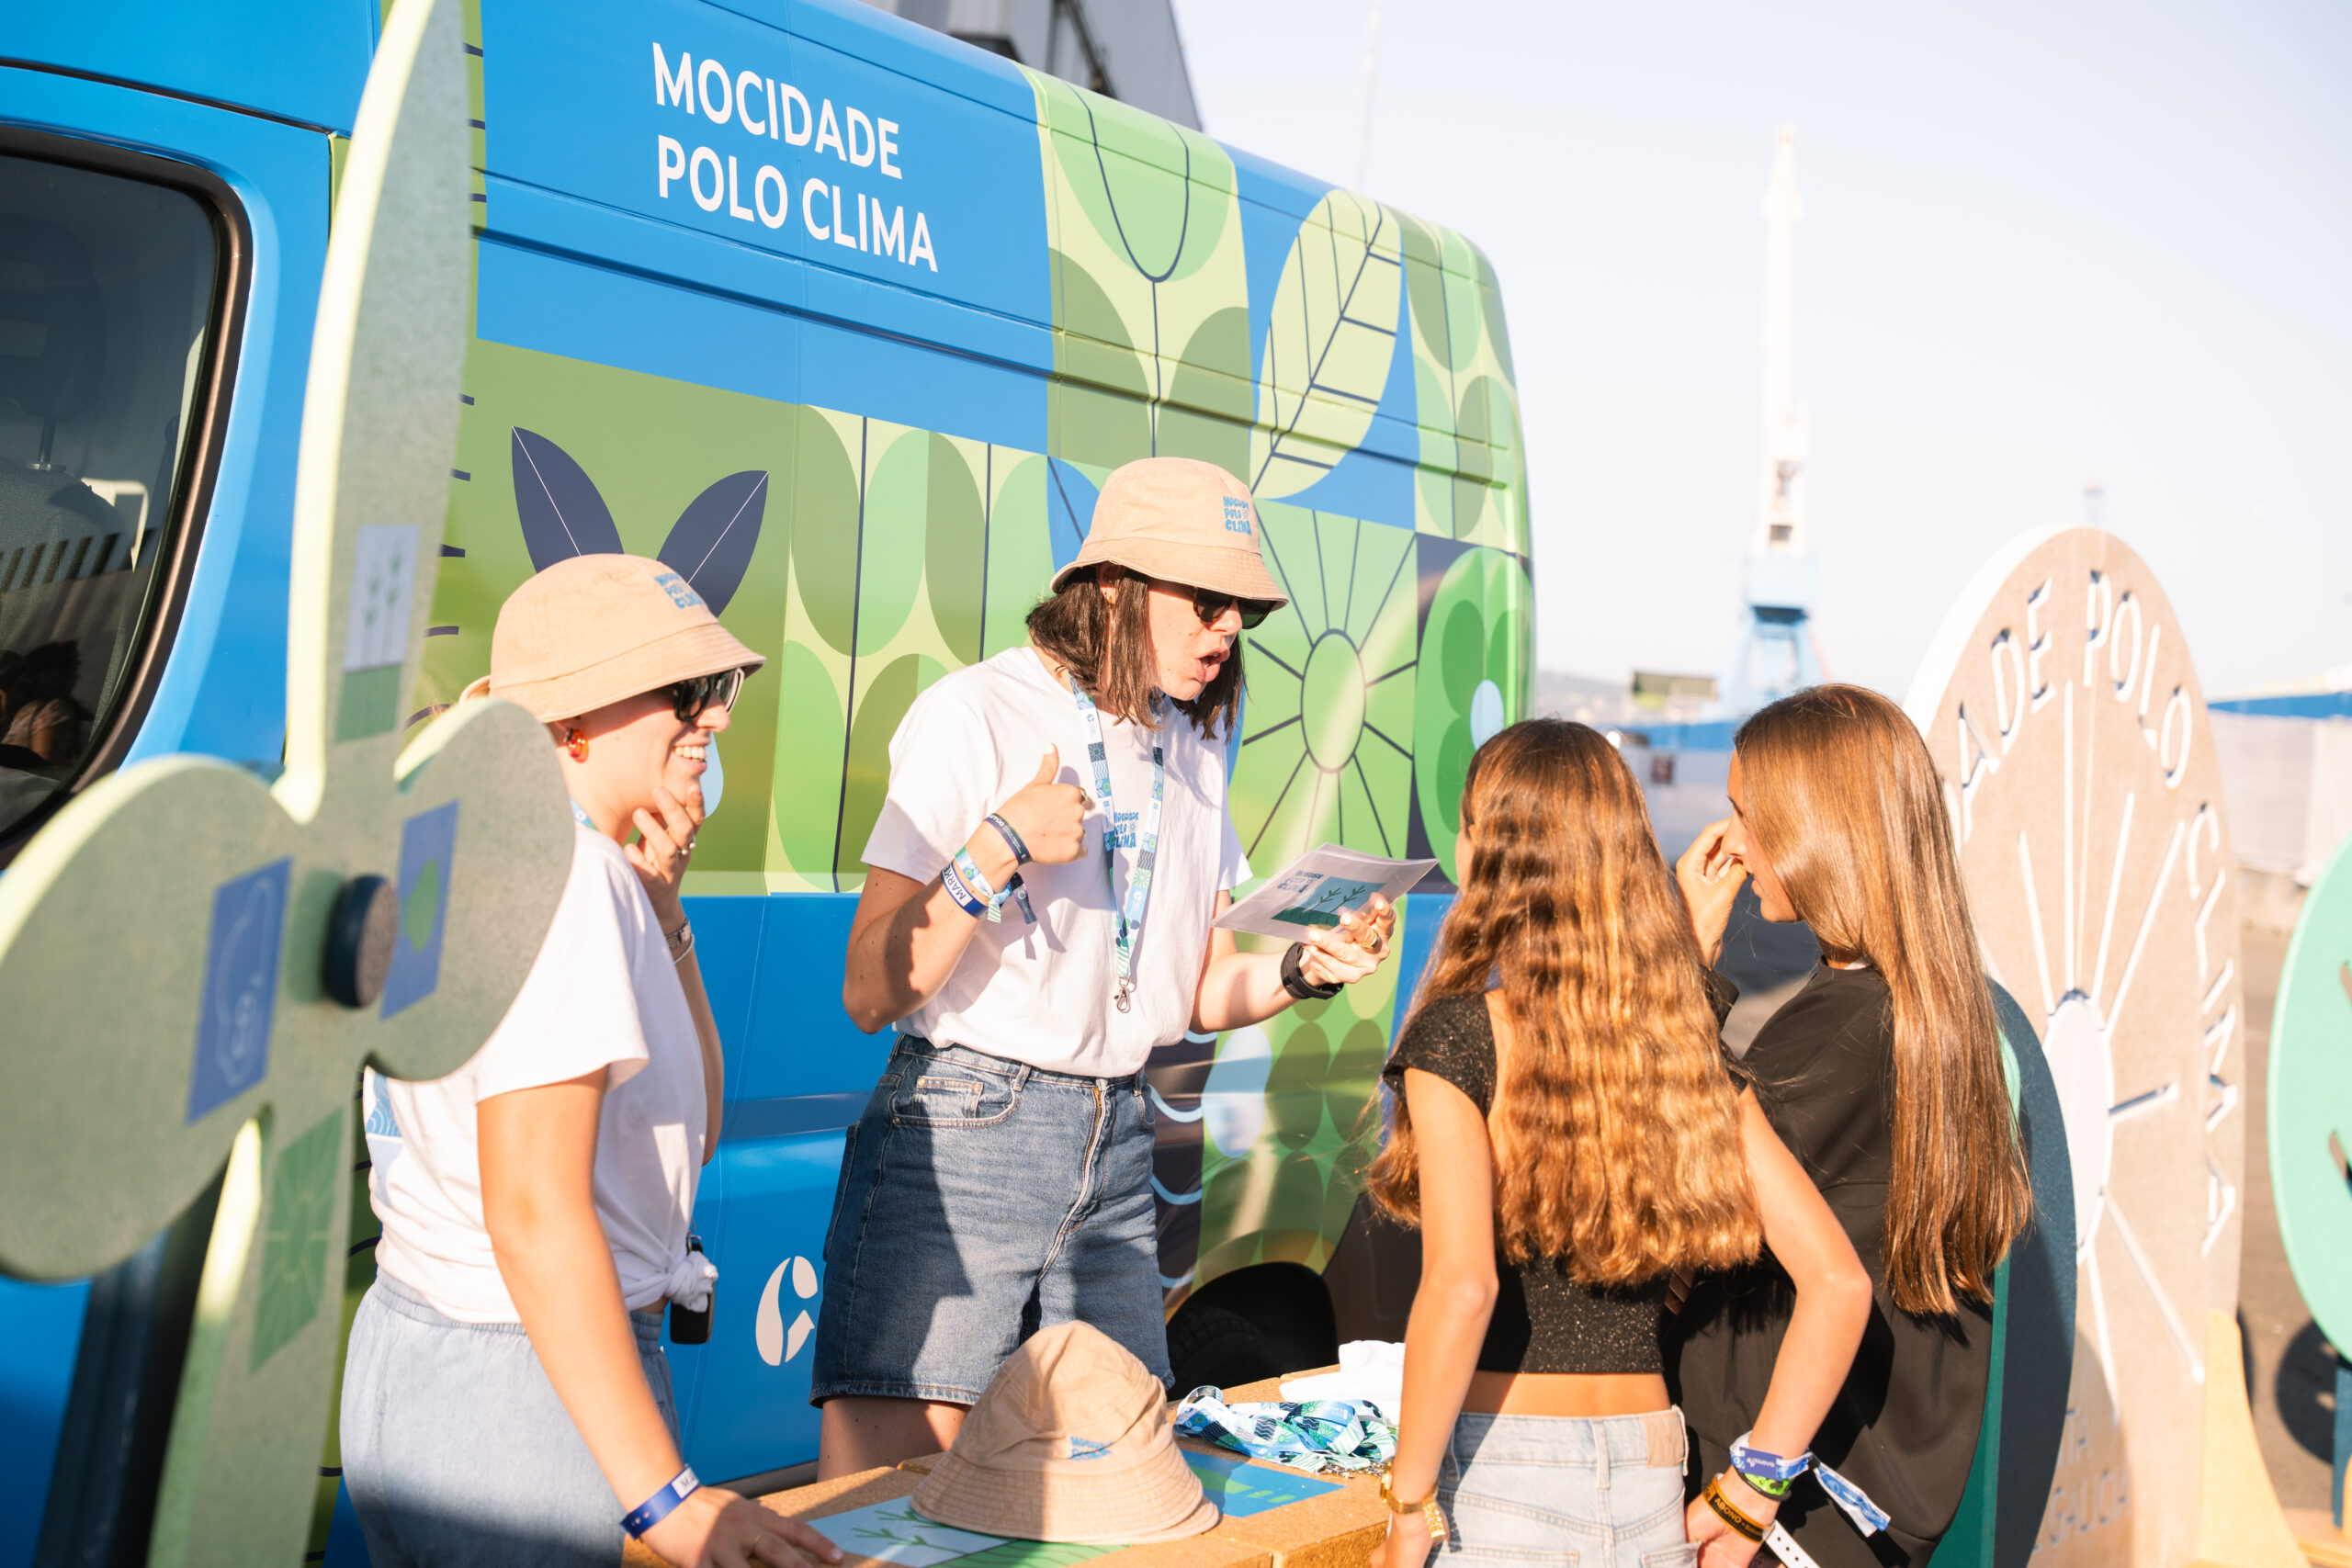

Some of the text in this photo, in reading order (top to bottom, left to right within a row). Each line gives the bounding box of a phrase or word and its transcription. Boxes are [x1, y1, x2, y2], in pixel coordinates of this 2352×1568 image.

[652, 41, 903, 180] MOCIDADE
[658, 134, 939, 273] POLO CLIMA
[2083, 568, 2192, 790] POLO
[1114, 832, 1136, 848] LIMA
[1714, 1497, 1742, 1524] ABONO
